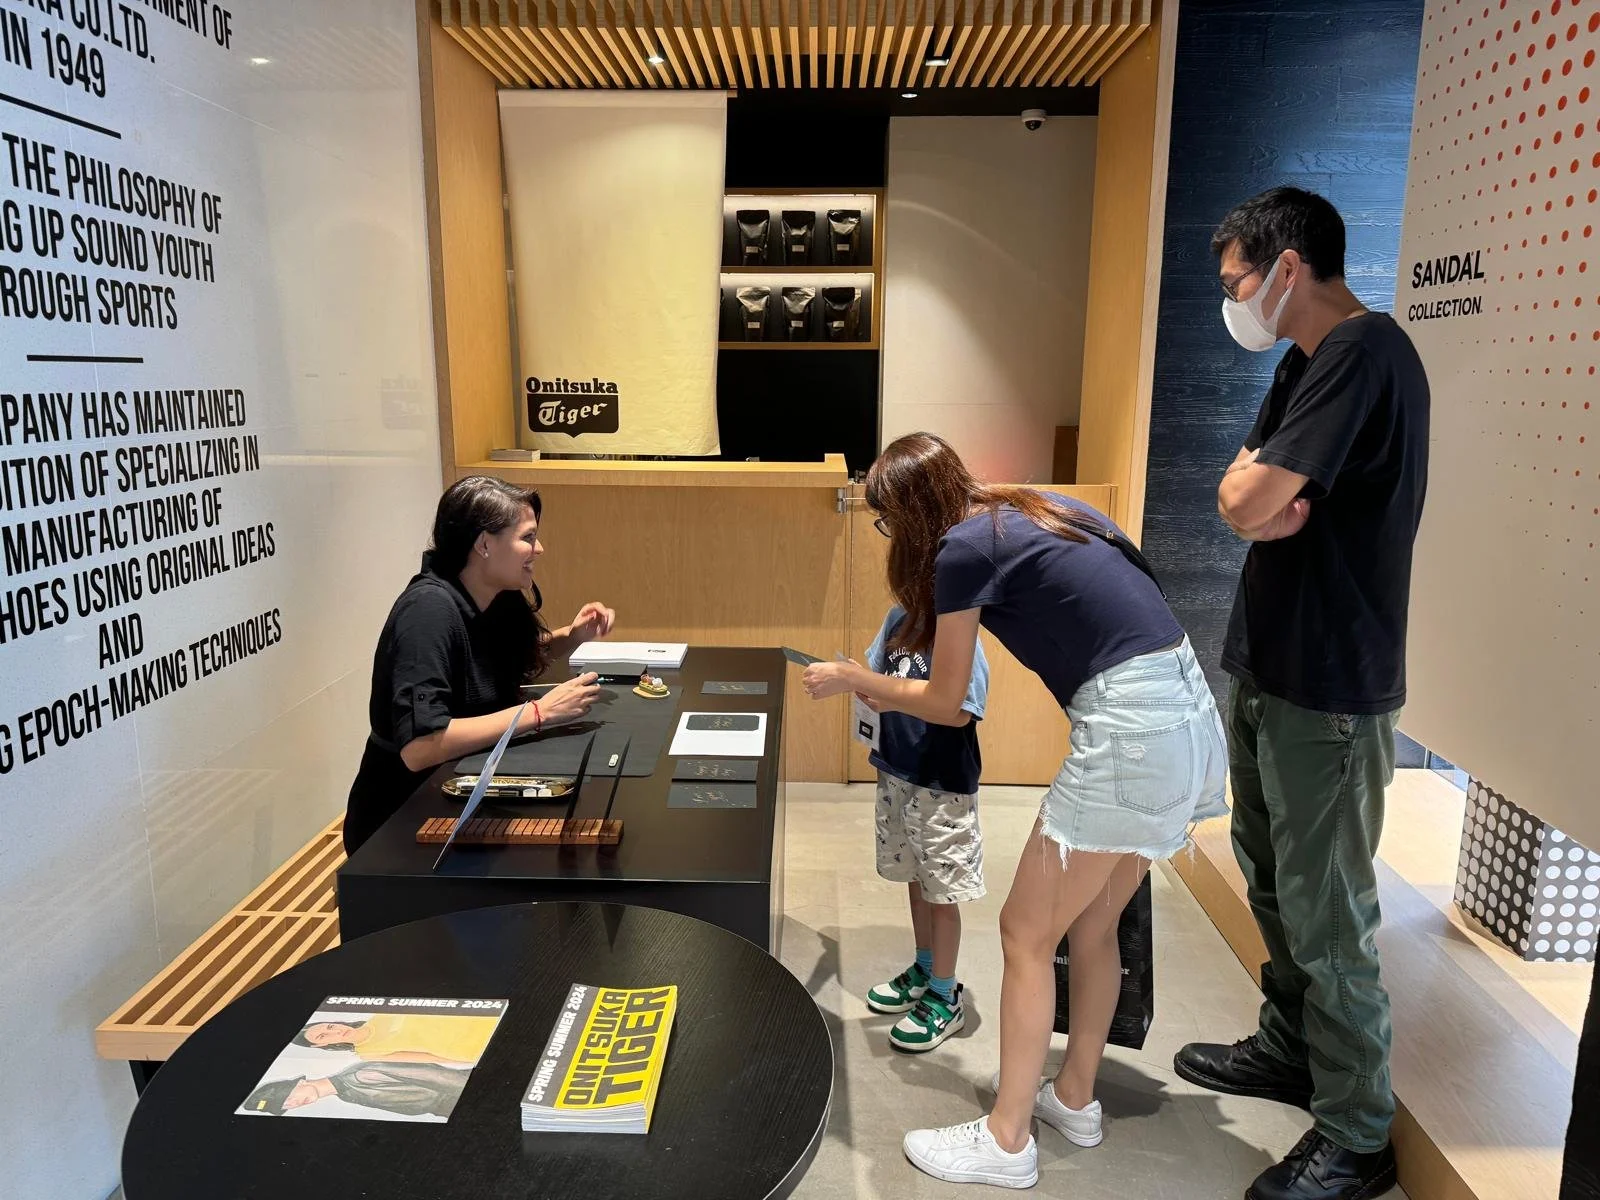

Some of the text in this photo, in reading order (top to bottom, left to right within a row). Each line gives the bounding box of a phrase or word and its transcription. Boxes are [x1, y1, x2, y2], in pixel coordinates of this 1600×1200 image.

[0, 7, 106, 98] IN 1949
[212, 5, 233, 50] OF
[1, 132, 222, 235] THE PHILOSOPHY OF
[28, 204, 65, 259] UP
[70, 213, 149, 272] SOUND
[150, 230, 215, 283] YOUTH
[1411, 250, 1485, 289] SANDAL
[95, 277, 178, 330] SPORTS
[1408, 295, 1482, 322] COLLECTION
[0, 389, 246, 446] PANY HAS MAINTAINED
[525, 376, 619, 394] Onitsuka
[538, 400, 608, 426] Tiger
[0, 434, 260, 511] ITION OF SPECIALIZING IN
[1, 487, 222, 577] MANUFACTURING OF
[72, 557, 143, 618] USING
[146, 534, 231, 595] ORIGINAL
[231, 522, 276, 569] IDEAS
[99, 612, 144, 670] AND
[913, 652, 928, 675] YOUR
[17, 648, 188, 765] EPOCH-MAKING
[188, 607, 282, 681] TECHNIQUES
[326, 996, 503, 1009] SPRING SUMMER 2024
[528, 985, 588, 1103] SPRING SUMMER 2024
[563, 991, 628, 1105] ONITSUKA
[592, 988, 671, 1105] TIGER
